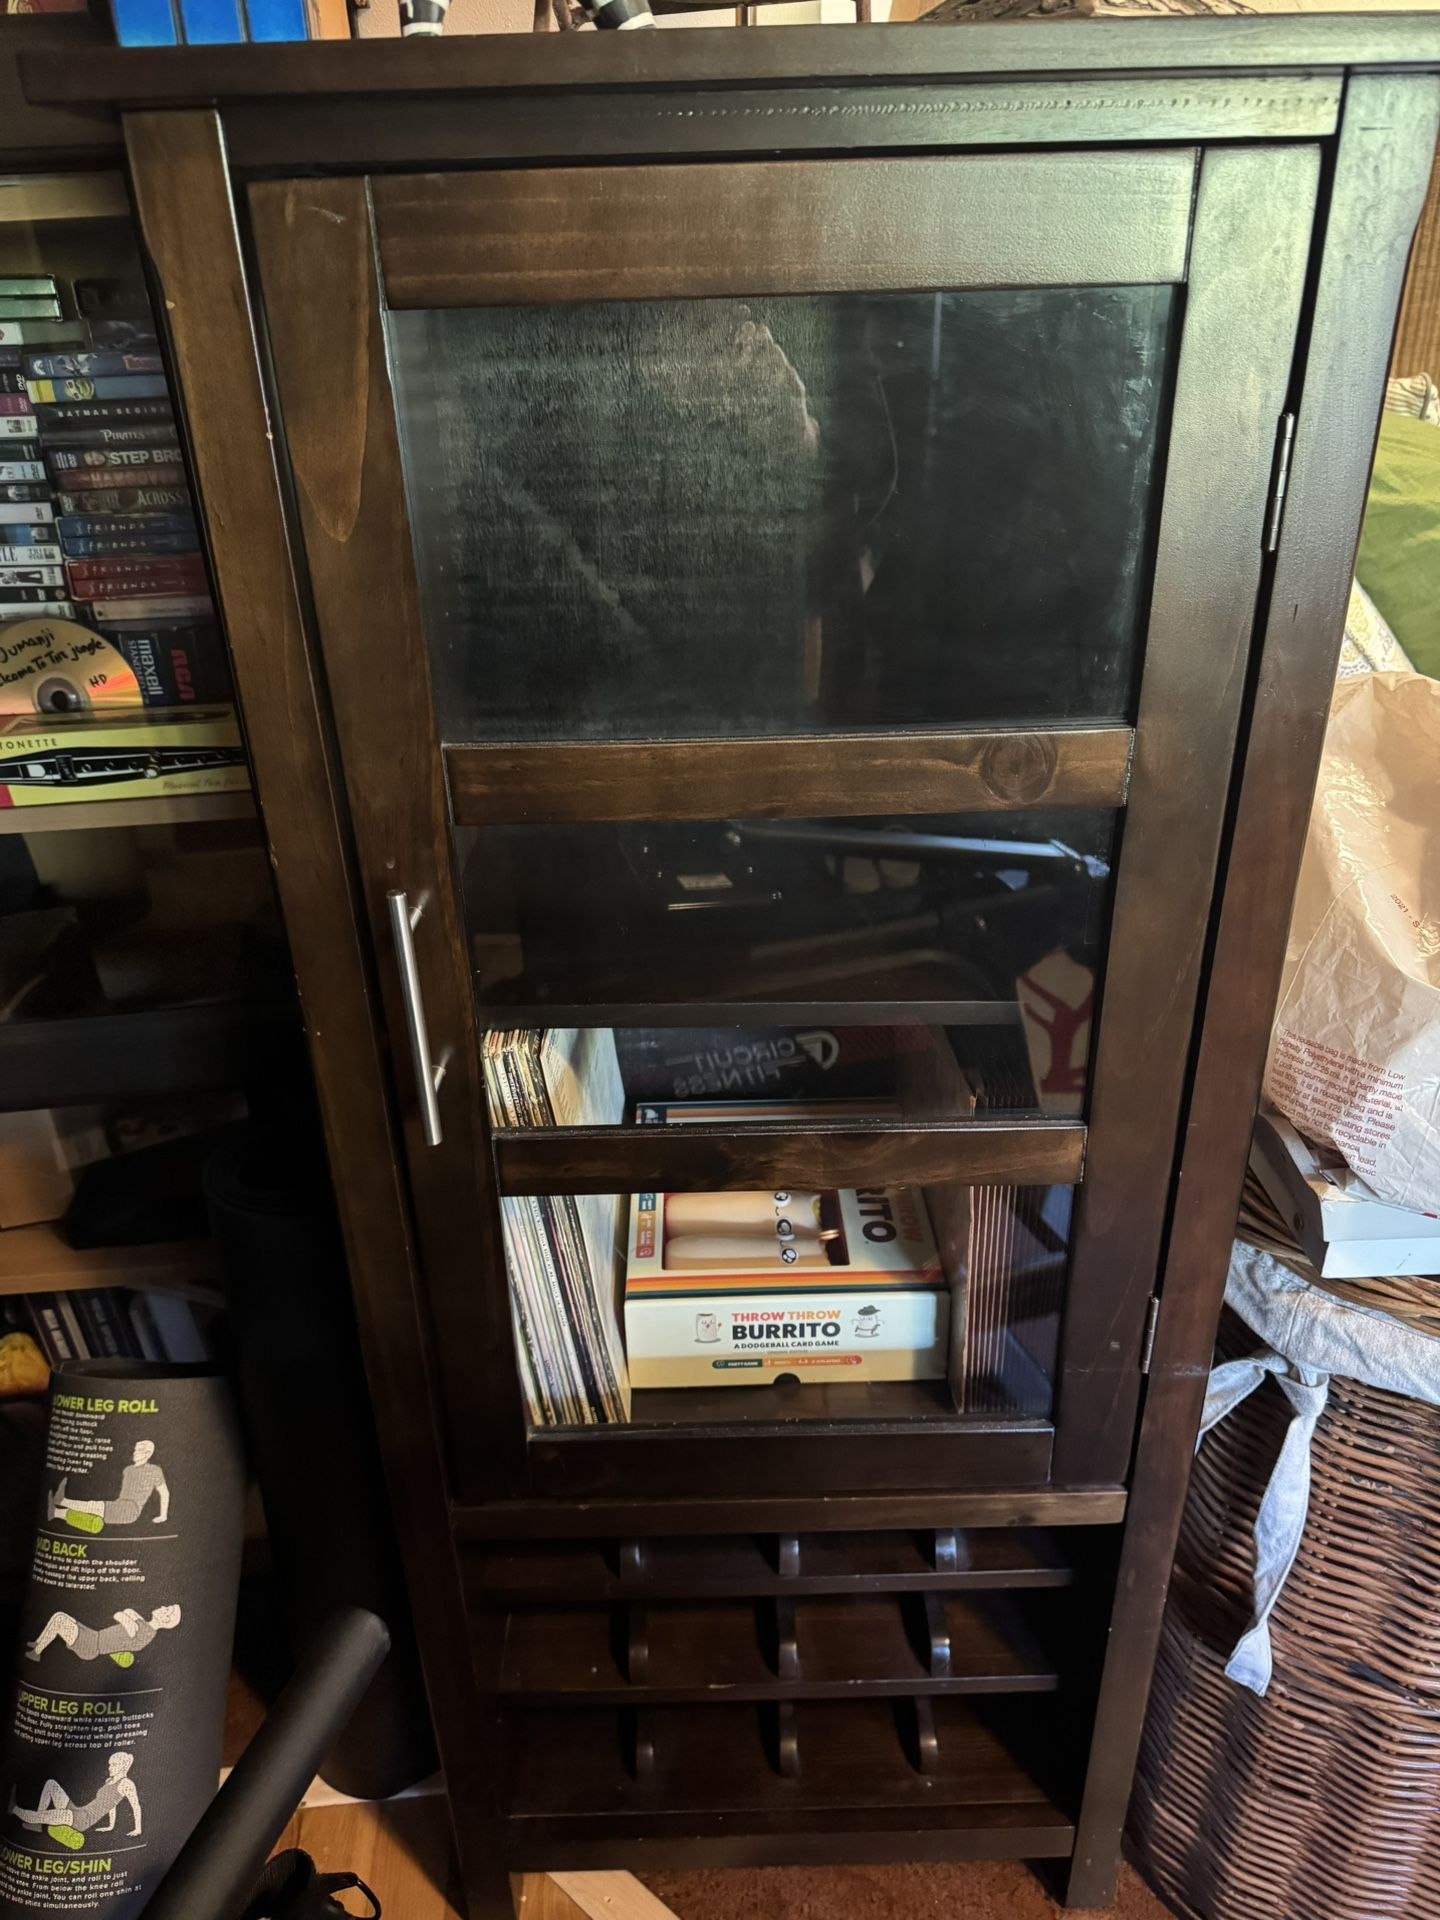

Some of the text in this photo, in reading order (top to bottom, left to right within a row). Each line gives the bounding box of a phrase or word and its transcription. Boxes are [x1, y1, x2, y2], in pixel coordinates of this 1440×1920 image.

[109, 451, 149, 465] STEP
[137, 639, 164, 696] maxell
[89, 674, 108, 688] HD
[1391, 894, 1409, 913] 2021
[1325, 1044, 1339, 1057] bag
[1346, 1054, 1367, 1068] made
[1367, 1062, 1386, 1076] from
[1345, 1063, 1360, 1076] with
[1367, 1074, 1404, 1090] minimum
[1356, 1081, 1379, 1097] partly
[1379, 1089, 1403, 1100] made
[1328, 1102, 1343, 1114] 125
[1366, 1116, 1396, 1131] Please
[1349, 1100, 1365, 1113] bag
[1367, 1108, 1384, 1117] and
[1335, 1127, 1377, 1146] recyclable
[1356, 1165, 1376, 1176] toxic
[732, 1310, 841, 1322] THROW THROW
[732, 1322, 841, 1340] BURRITO
[86, 1397, 114, 1413] LEG
[117, 1399, 159, 1414] ROLL
[52, 1541, 88, 1558] BACK
[51, 1699, 79, 1715] LEG
[82, 1701, 125, 1715] ROLL
[122, 1712, 154, 1722] buttocks
[35, 1858, 112, 1875] LEG/SHIN
[112, 1871, 128, 1881] just
